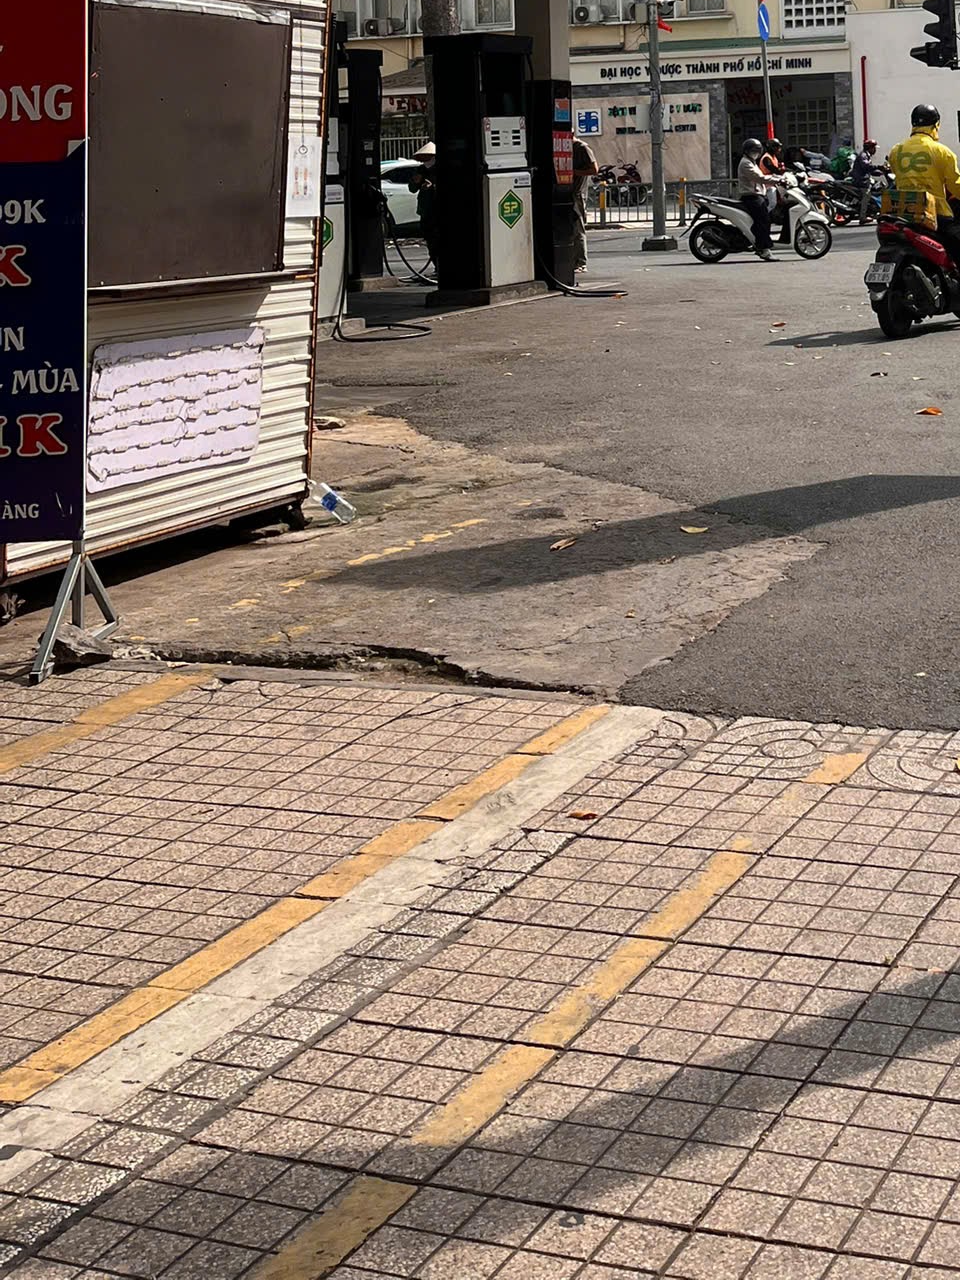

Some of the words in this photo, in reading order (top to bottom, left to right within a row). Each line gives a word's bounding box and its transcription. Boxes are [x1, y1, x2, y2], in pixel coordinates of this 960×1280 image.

[600, 67, 617, 80] ĐẠI
[620, 66, 642, 79] HỌC
[685, 61, 720, 74] THÀNH
[723, 57, 745, 72] PHỐ
[747, 56, 762, 70] HỒ
[785, 57, 812, 69] MINH
[0, 84, 73, 121] NG
[0, 199, 46, 225] 9K
[503, 202, 518, 213] SP
[11, 361, 80, 395] MÙA
[2, 499, 40, 520] ÀNG
